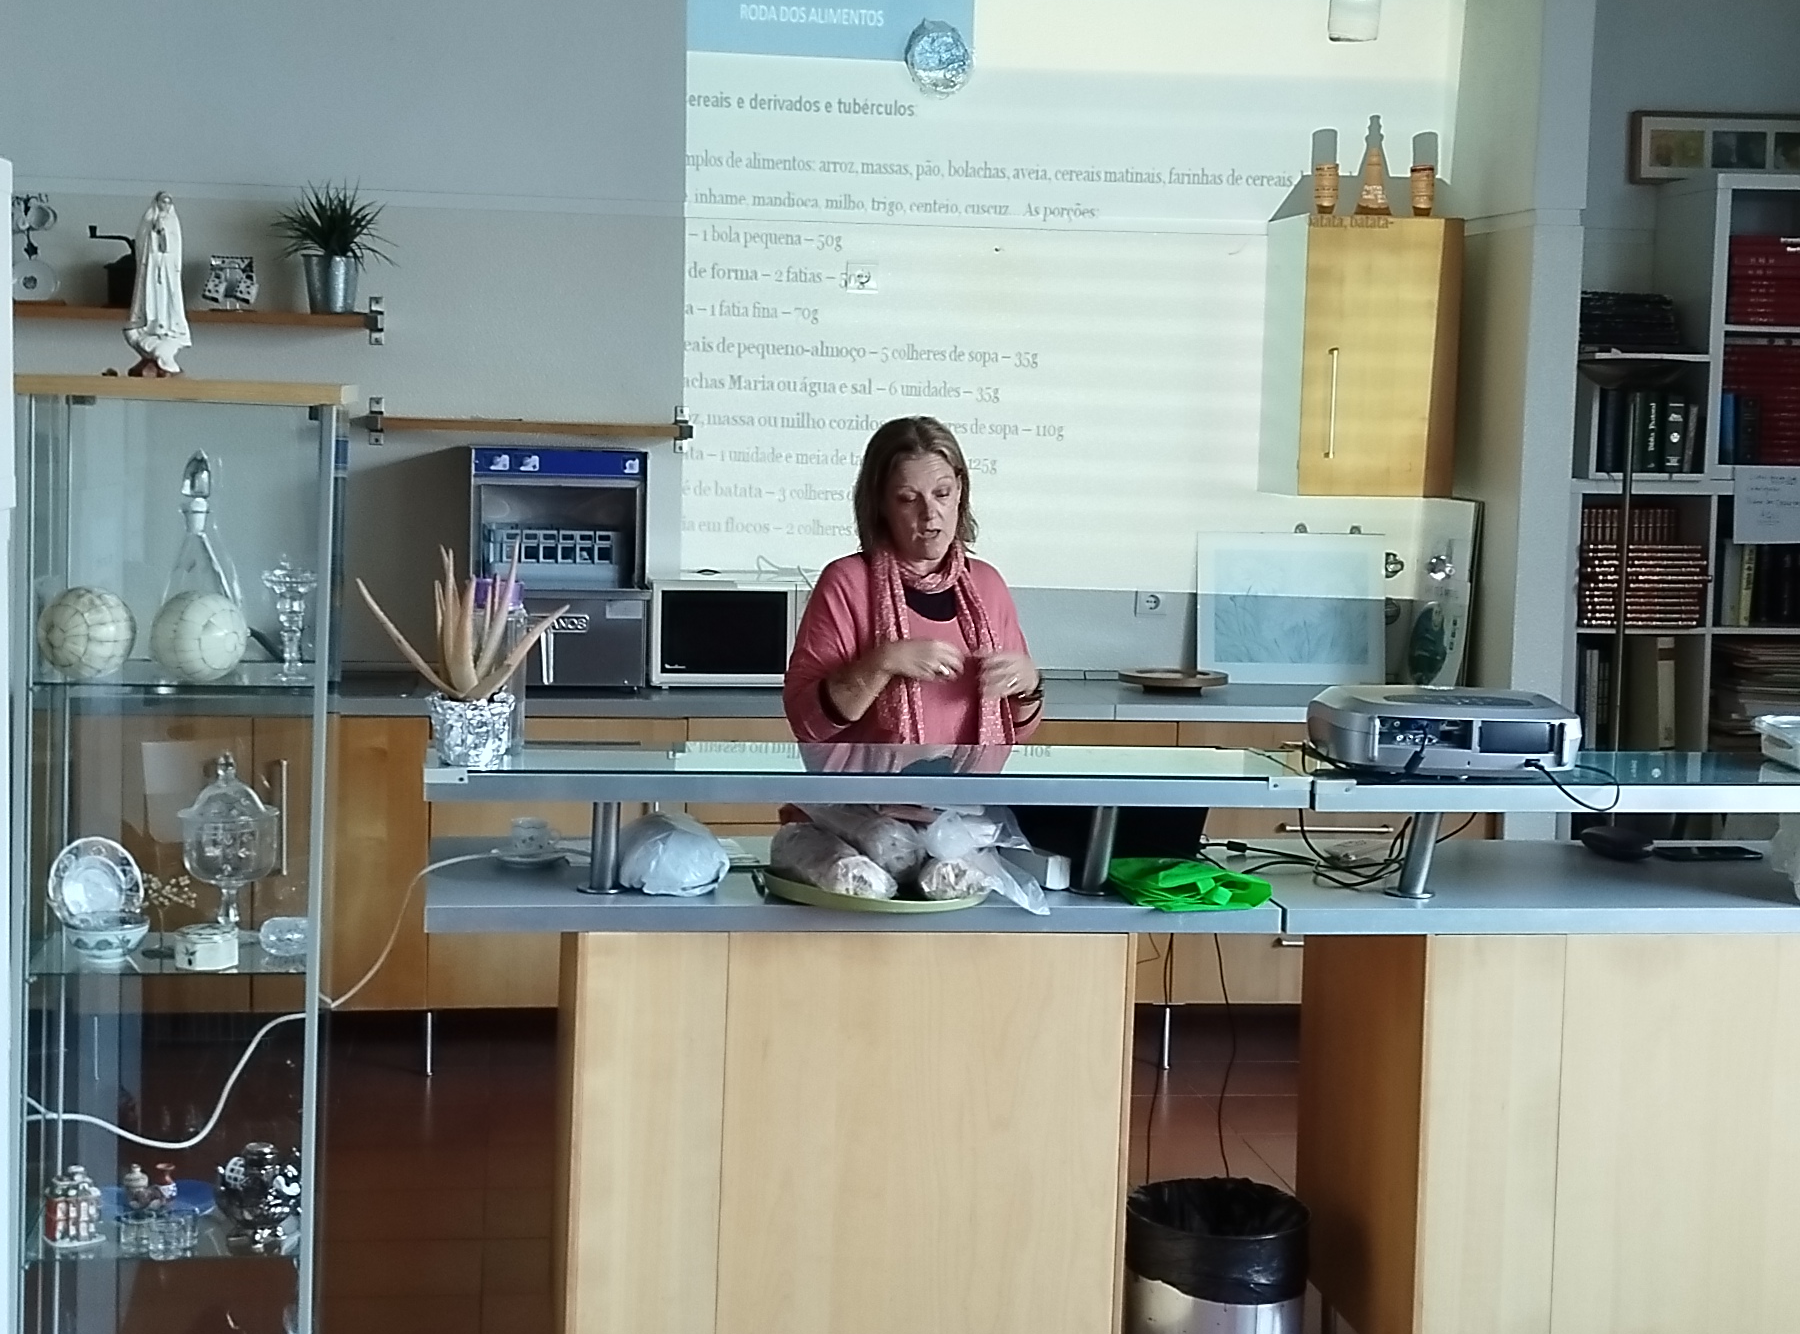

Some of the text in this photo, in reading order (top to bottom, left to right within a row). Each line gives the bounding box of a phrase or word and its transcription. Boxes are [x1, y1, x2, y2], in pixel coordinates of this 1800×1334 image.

[740, 4, 884, 27] RODA DOS ALIMENTOS
[687, 91, 732, 109] ereais
[737, 96, 745, 108] e
[749, 93, 820, 113] derivados
[825, 101, 833, 113] e
[726, 151, 742, 168] de
[745, 151, 815, 172] alimentos:
[861, 161, 912, 177] massas,
[916, 160, 944, 181] pão,
[948, 160, 1010, 181] bolachas,
[1012, 164, 1051, 182] aveia,
[1054, 165, 1101, 182] cereais
[1103, 167, 1166, 186] matinais,
[1168, 167, 1223, 186] farinhas
[1226, 168, 1243, 186] de
[1023, 202, 1040, 217] As
[711, 225, 741, 244] bola
[743, 229, 802, 250] pequena
[817, 234, 843, 253] 50g
[688, 261, 707, 279] de
[711, 263, 759, 282] forma
[774, 270, 783, 283] 2
[786, 266, 823, 284] fatias
[719, 300, 749, 317] fatia
[752, 302, 778, 319] fina
[685, 336, 714, 353] eais
[716, 336, 735, 354] de
[737, 340, 866, 363] pequeno-almoço
[880, 347, 889, 364] 5
[892, 343, 947, 362] colheres
[949, 345, 965, 362] de
[967, 349, 999, 368] sopa
[1014, 351, 1039, 369] 35g
[684, 372, 725, 390] achas
[728, 374, 775, 392] Maria
[777, 379, 796, 393] ou
[799, 376, 837, 398] água
[839, 383, 848, 395] e
[851, 378, 873, 396] sal
[888, 380, 898, 396] 6
[901, 380, 961, 398] unidades
[976, 386, 1000, 404] 35g
[706, 413, 755, 427] massa
[757, 415, 777, 428] ou
[780, 412, 826, 430] milho
[970, 417, 986, 435] de
[988, 423, 1019, 440] sopa
[1036, 424, 1064, 442] 110g
[729, 446, 784, 463] unidade
[785, 452, 793, 463] e
[795, 449, 829, 465] meia
[831, 448, 847, 466] de
[693, 480, 712, 497] de
[715, 480, 762, 498] batata
[778, 489, 786, 503] 3
[789, 483, 844, 501] colheres
[698, 520, 721, 533] em
[725, 517, 770, 534] flocos
[786, 524, 795, 535] 2
[797, 519, 852, 537] colheres
